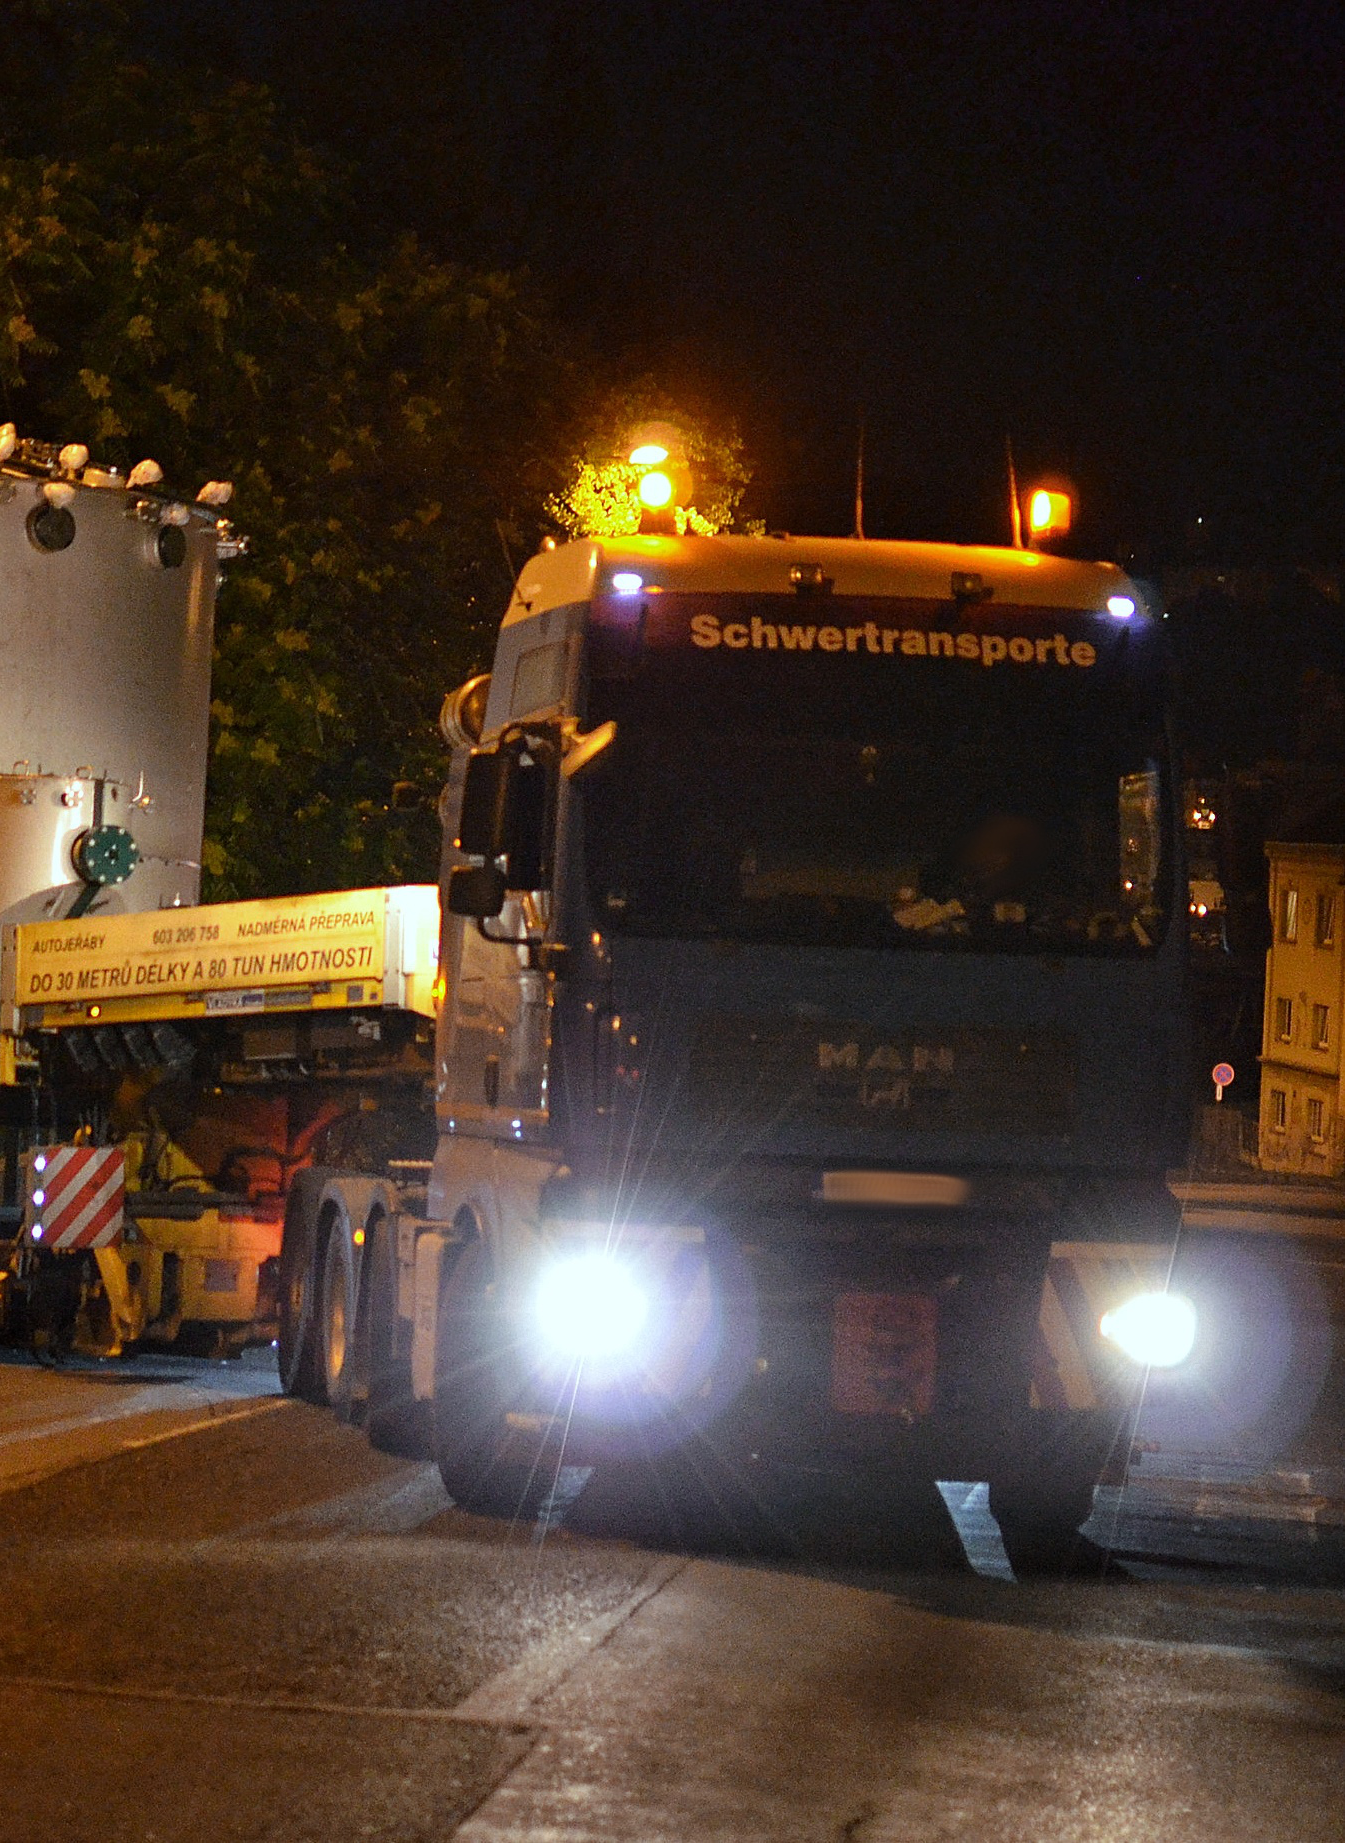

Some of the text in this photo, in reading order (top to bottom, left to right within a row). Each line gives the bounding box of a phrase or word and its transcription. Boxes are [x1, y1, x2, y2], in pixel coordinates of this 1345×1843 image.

[690, 613, 1097, 666] Schwertransporte
[153, 925, 219, 945] 603 206 758
[30, 974, 52, 993] DO
[56, 972, 73, 990] 30
[135, 960, 190, 984] DÉLKY
[193, 961, 204, 979] A
[208, 959, 227, 978] 80
[233, 954, 265, 976] TUN
[269, 946, 373, 974] HMOTNOSTI
[818, 1043, 955, 1072] MAN
